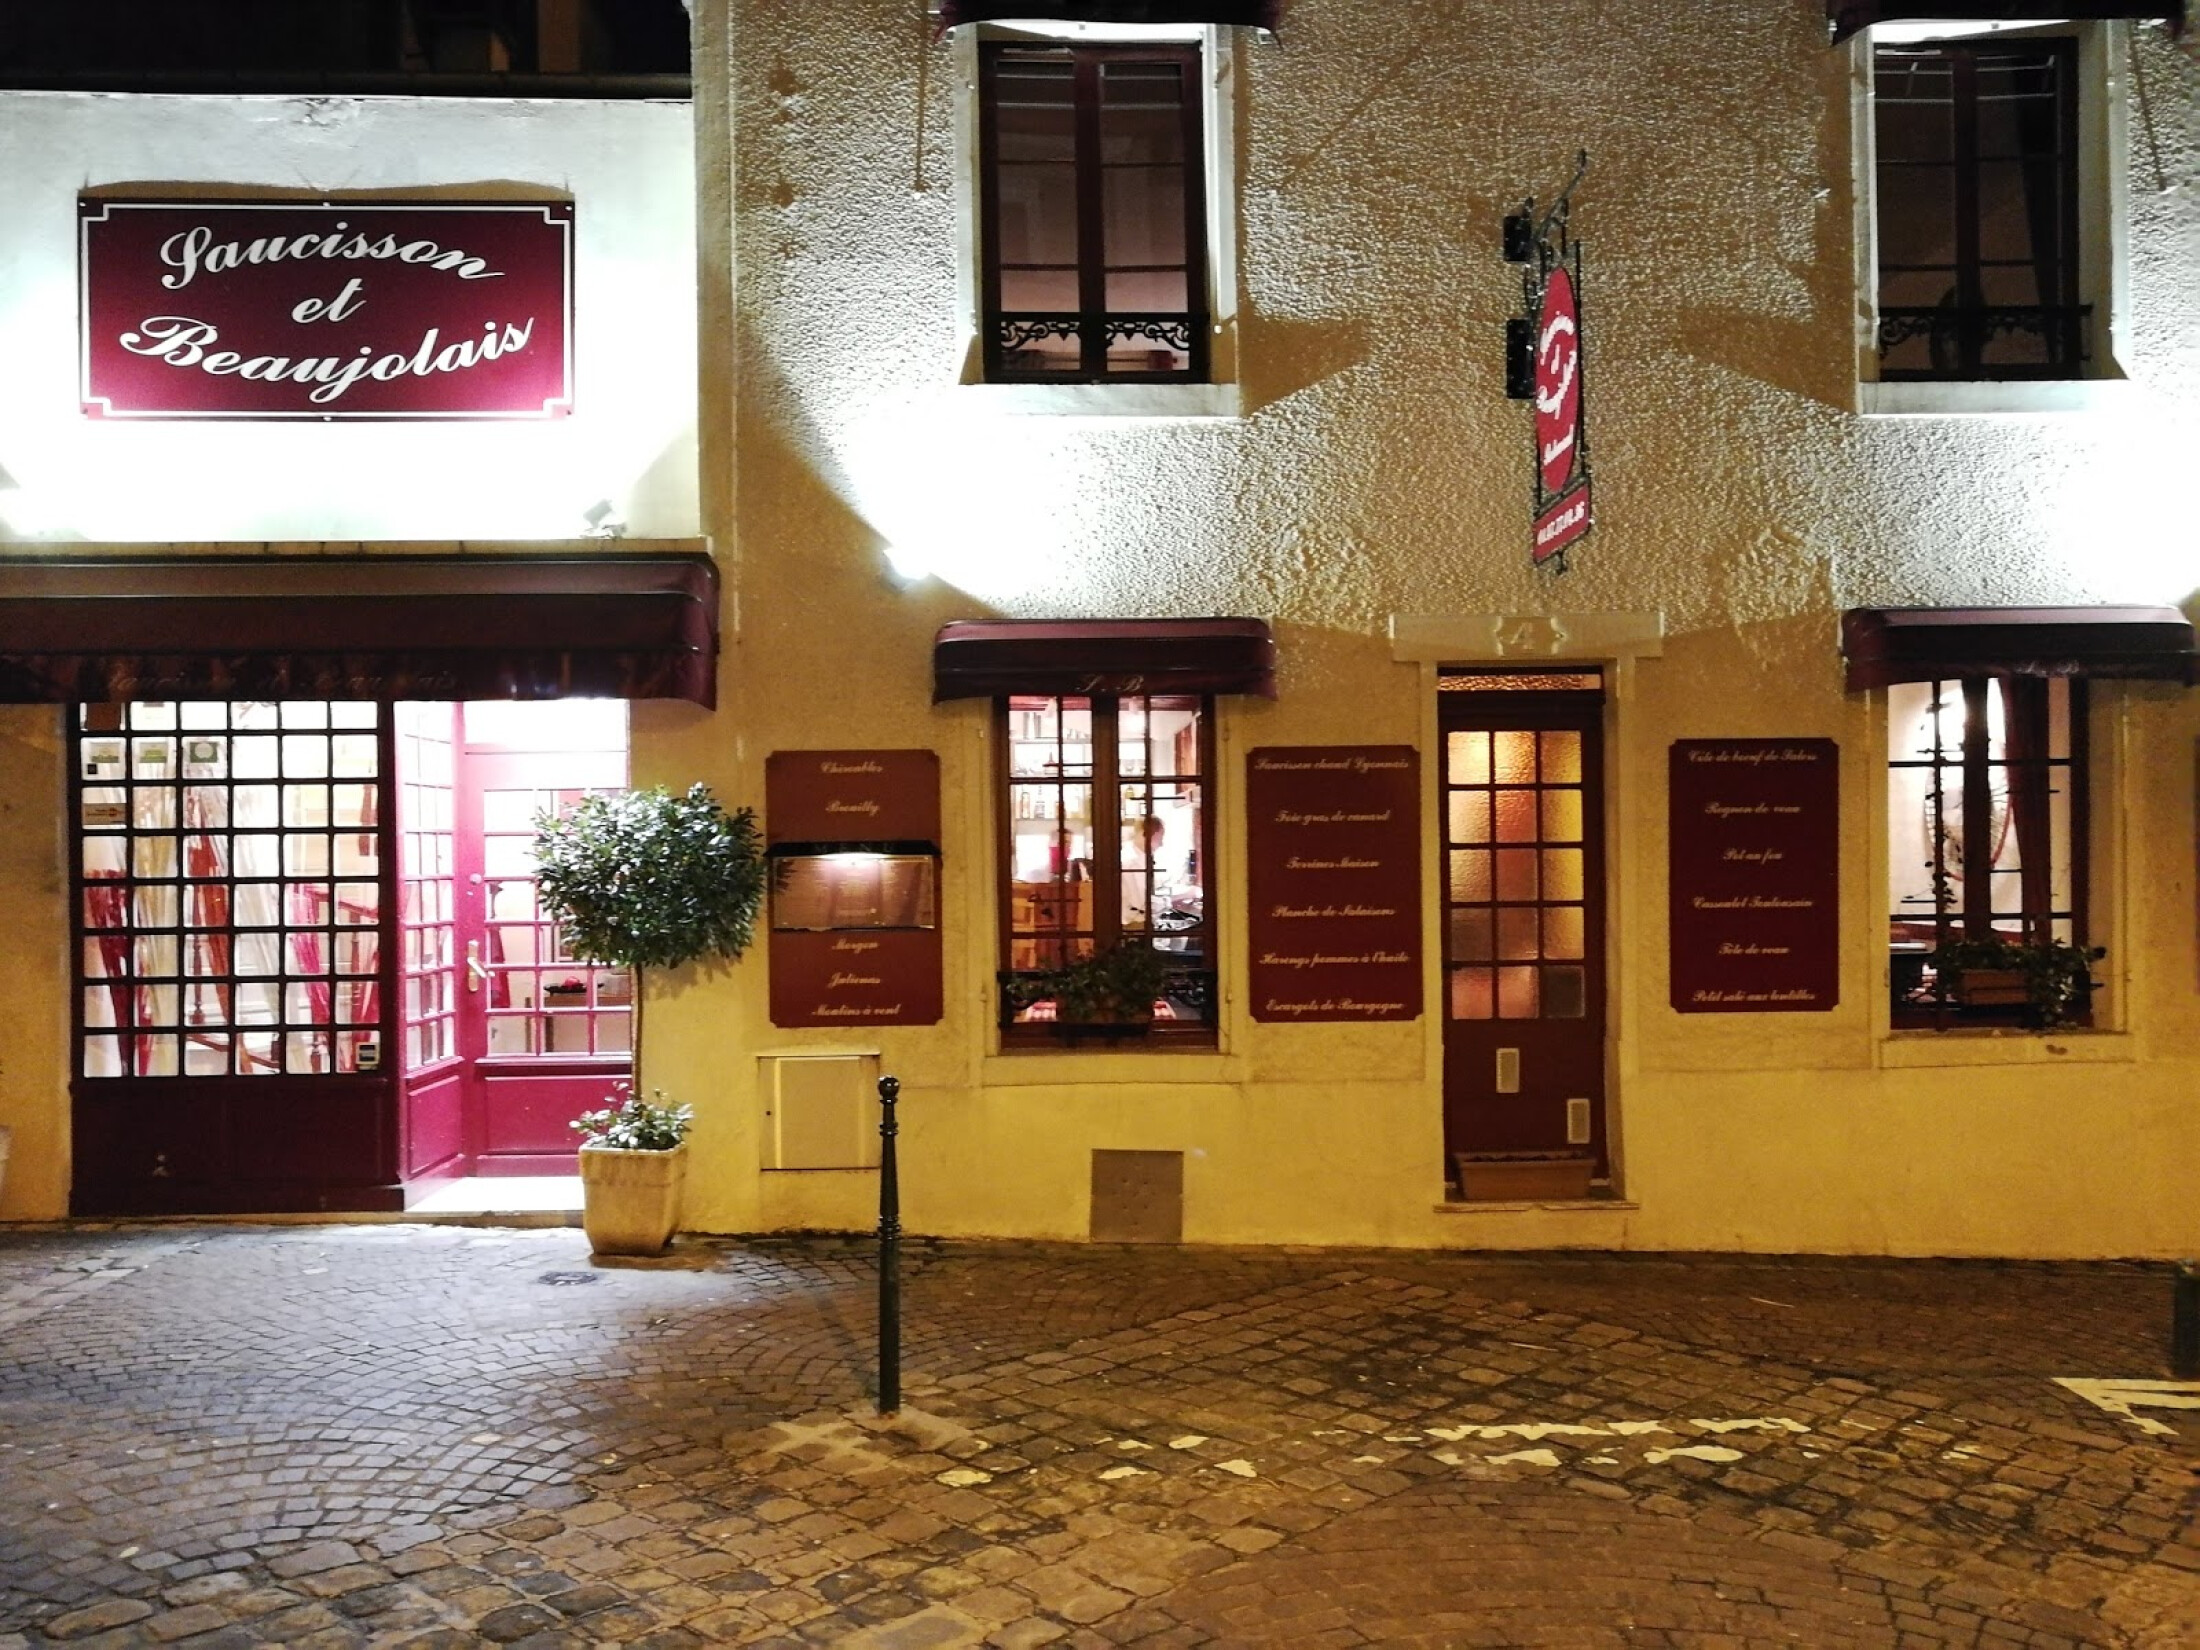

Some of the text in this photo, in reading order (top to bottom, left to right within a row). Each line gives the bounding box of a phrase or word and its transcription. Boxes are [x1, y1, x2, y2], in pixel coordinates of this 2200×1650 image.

[160, 221, 505, 289] Saucisson
[292, 278, 366, 324] et
[119, 315, 534, 404] Beaujolais
